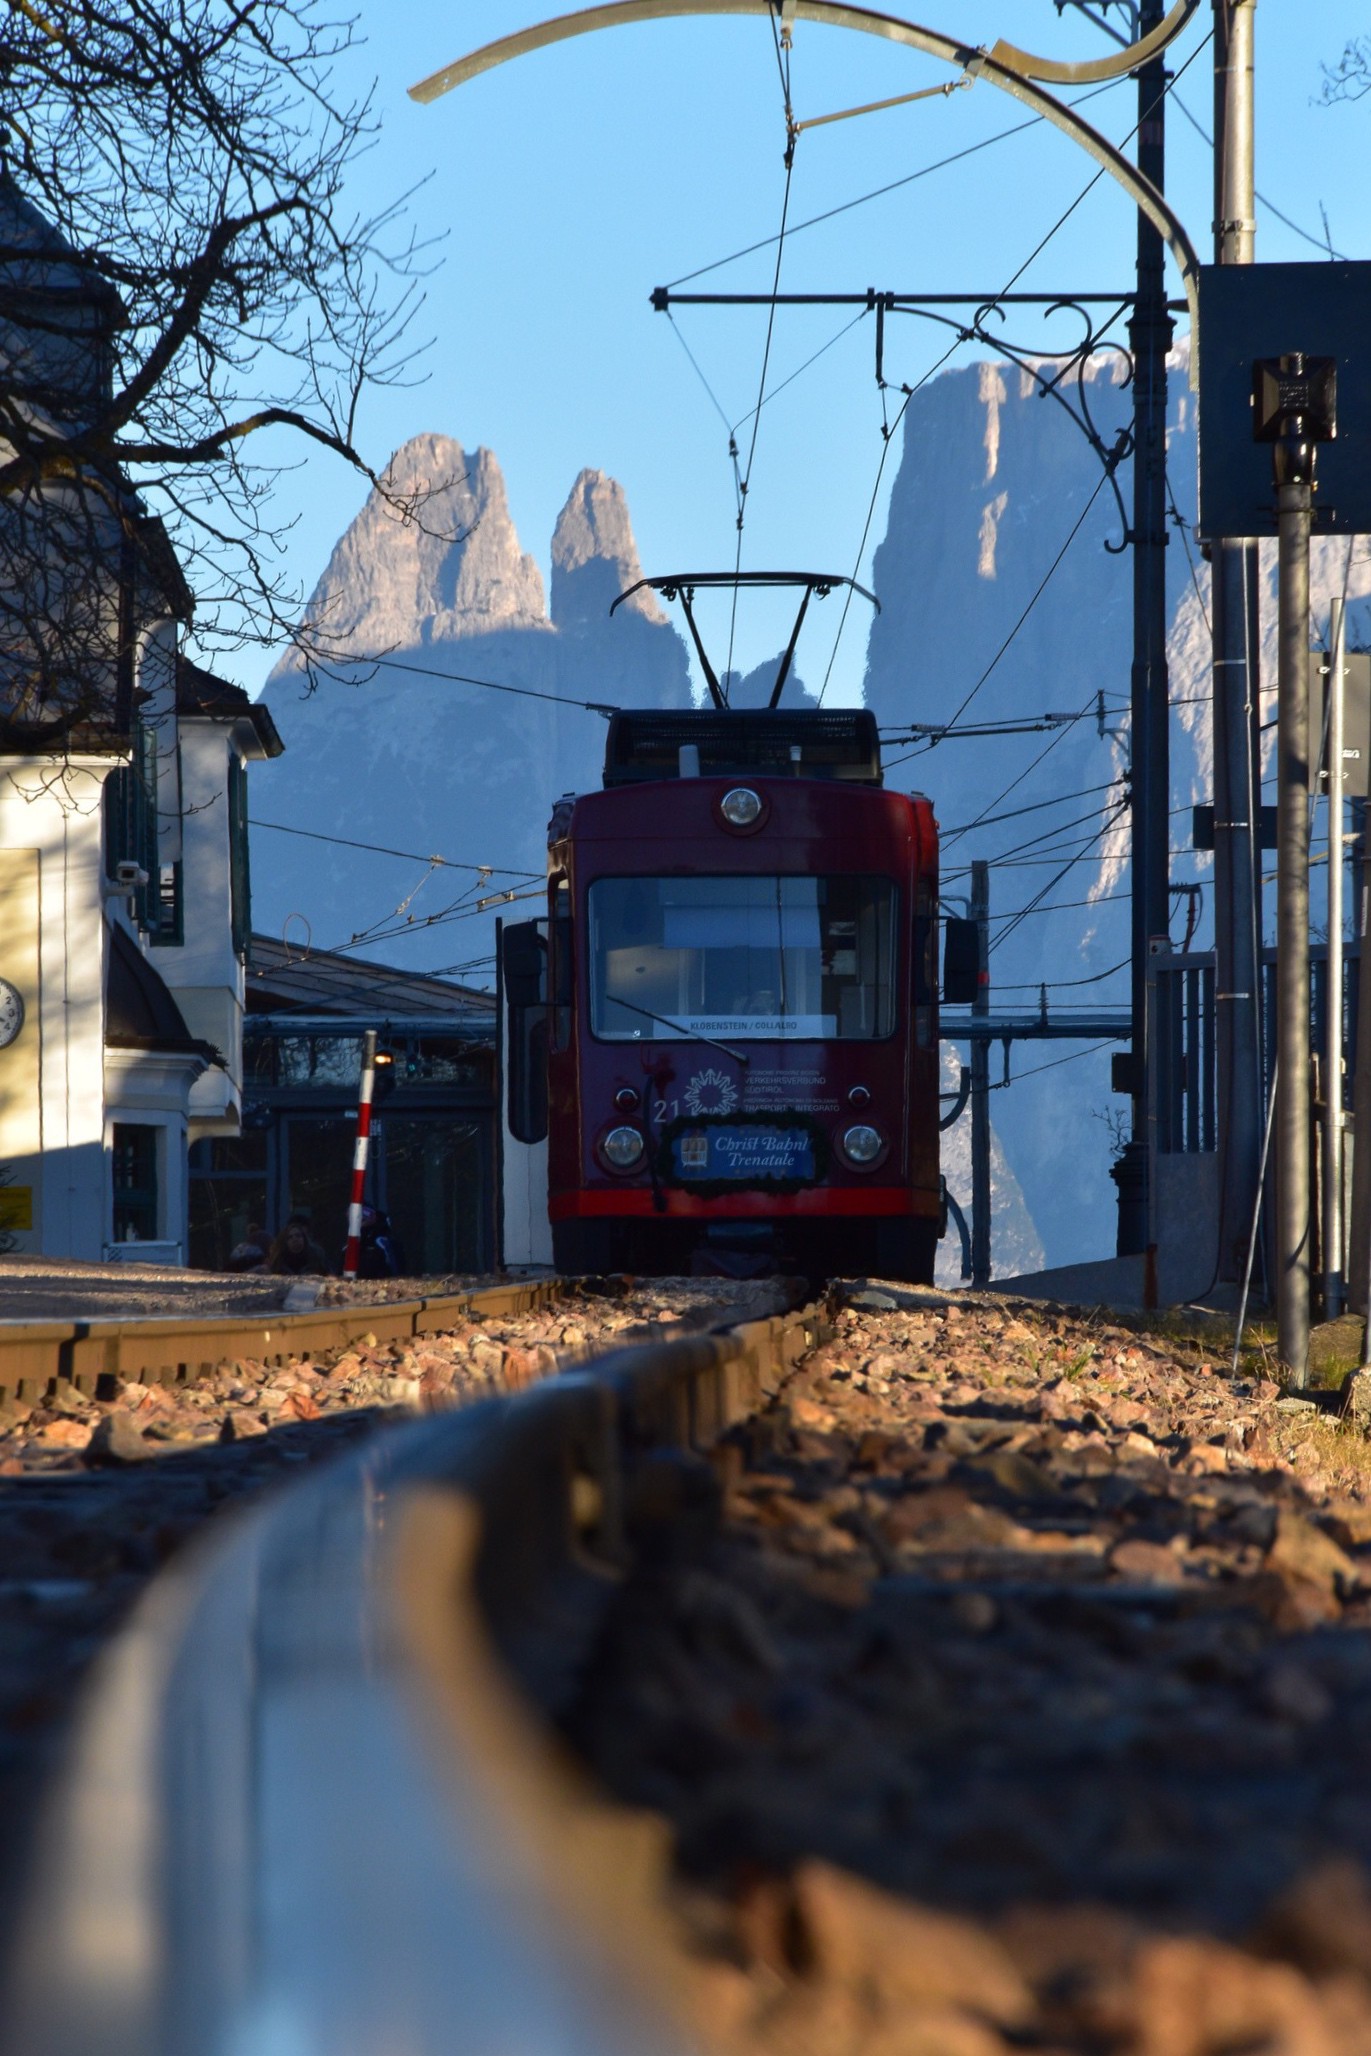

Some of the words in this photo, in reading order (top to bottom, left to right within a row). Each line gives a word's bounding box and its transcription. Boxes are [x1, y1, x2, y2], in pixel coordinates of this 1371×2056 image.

[5, 996, 12, 1004] 2
[8, 1008, 15, 1017] 3
[4, 1022, 11, 1030] 4
[690, 1022, 747, 1031] KLOBENSTEIN
[744, 1076, 826, 1085] VERKEHRSVERBUND
[744, 1085, 785, 1094] SÜDTIROL
[653, 1099, 679, 1123] 21
[795, 1103, 841, 1113] INTEGRATO
[715, 1136, 758, 1152] Christ
[727, 1152, 795, 1168] Trenatale
